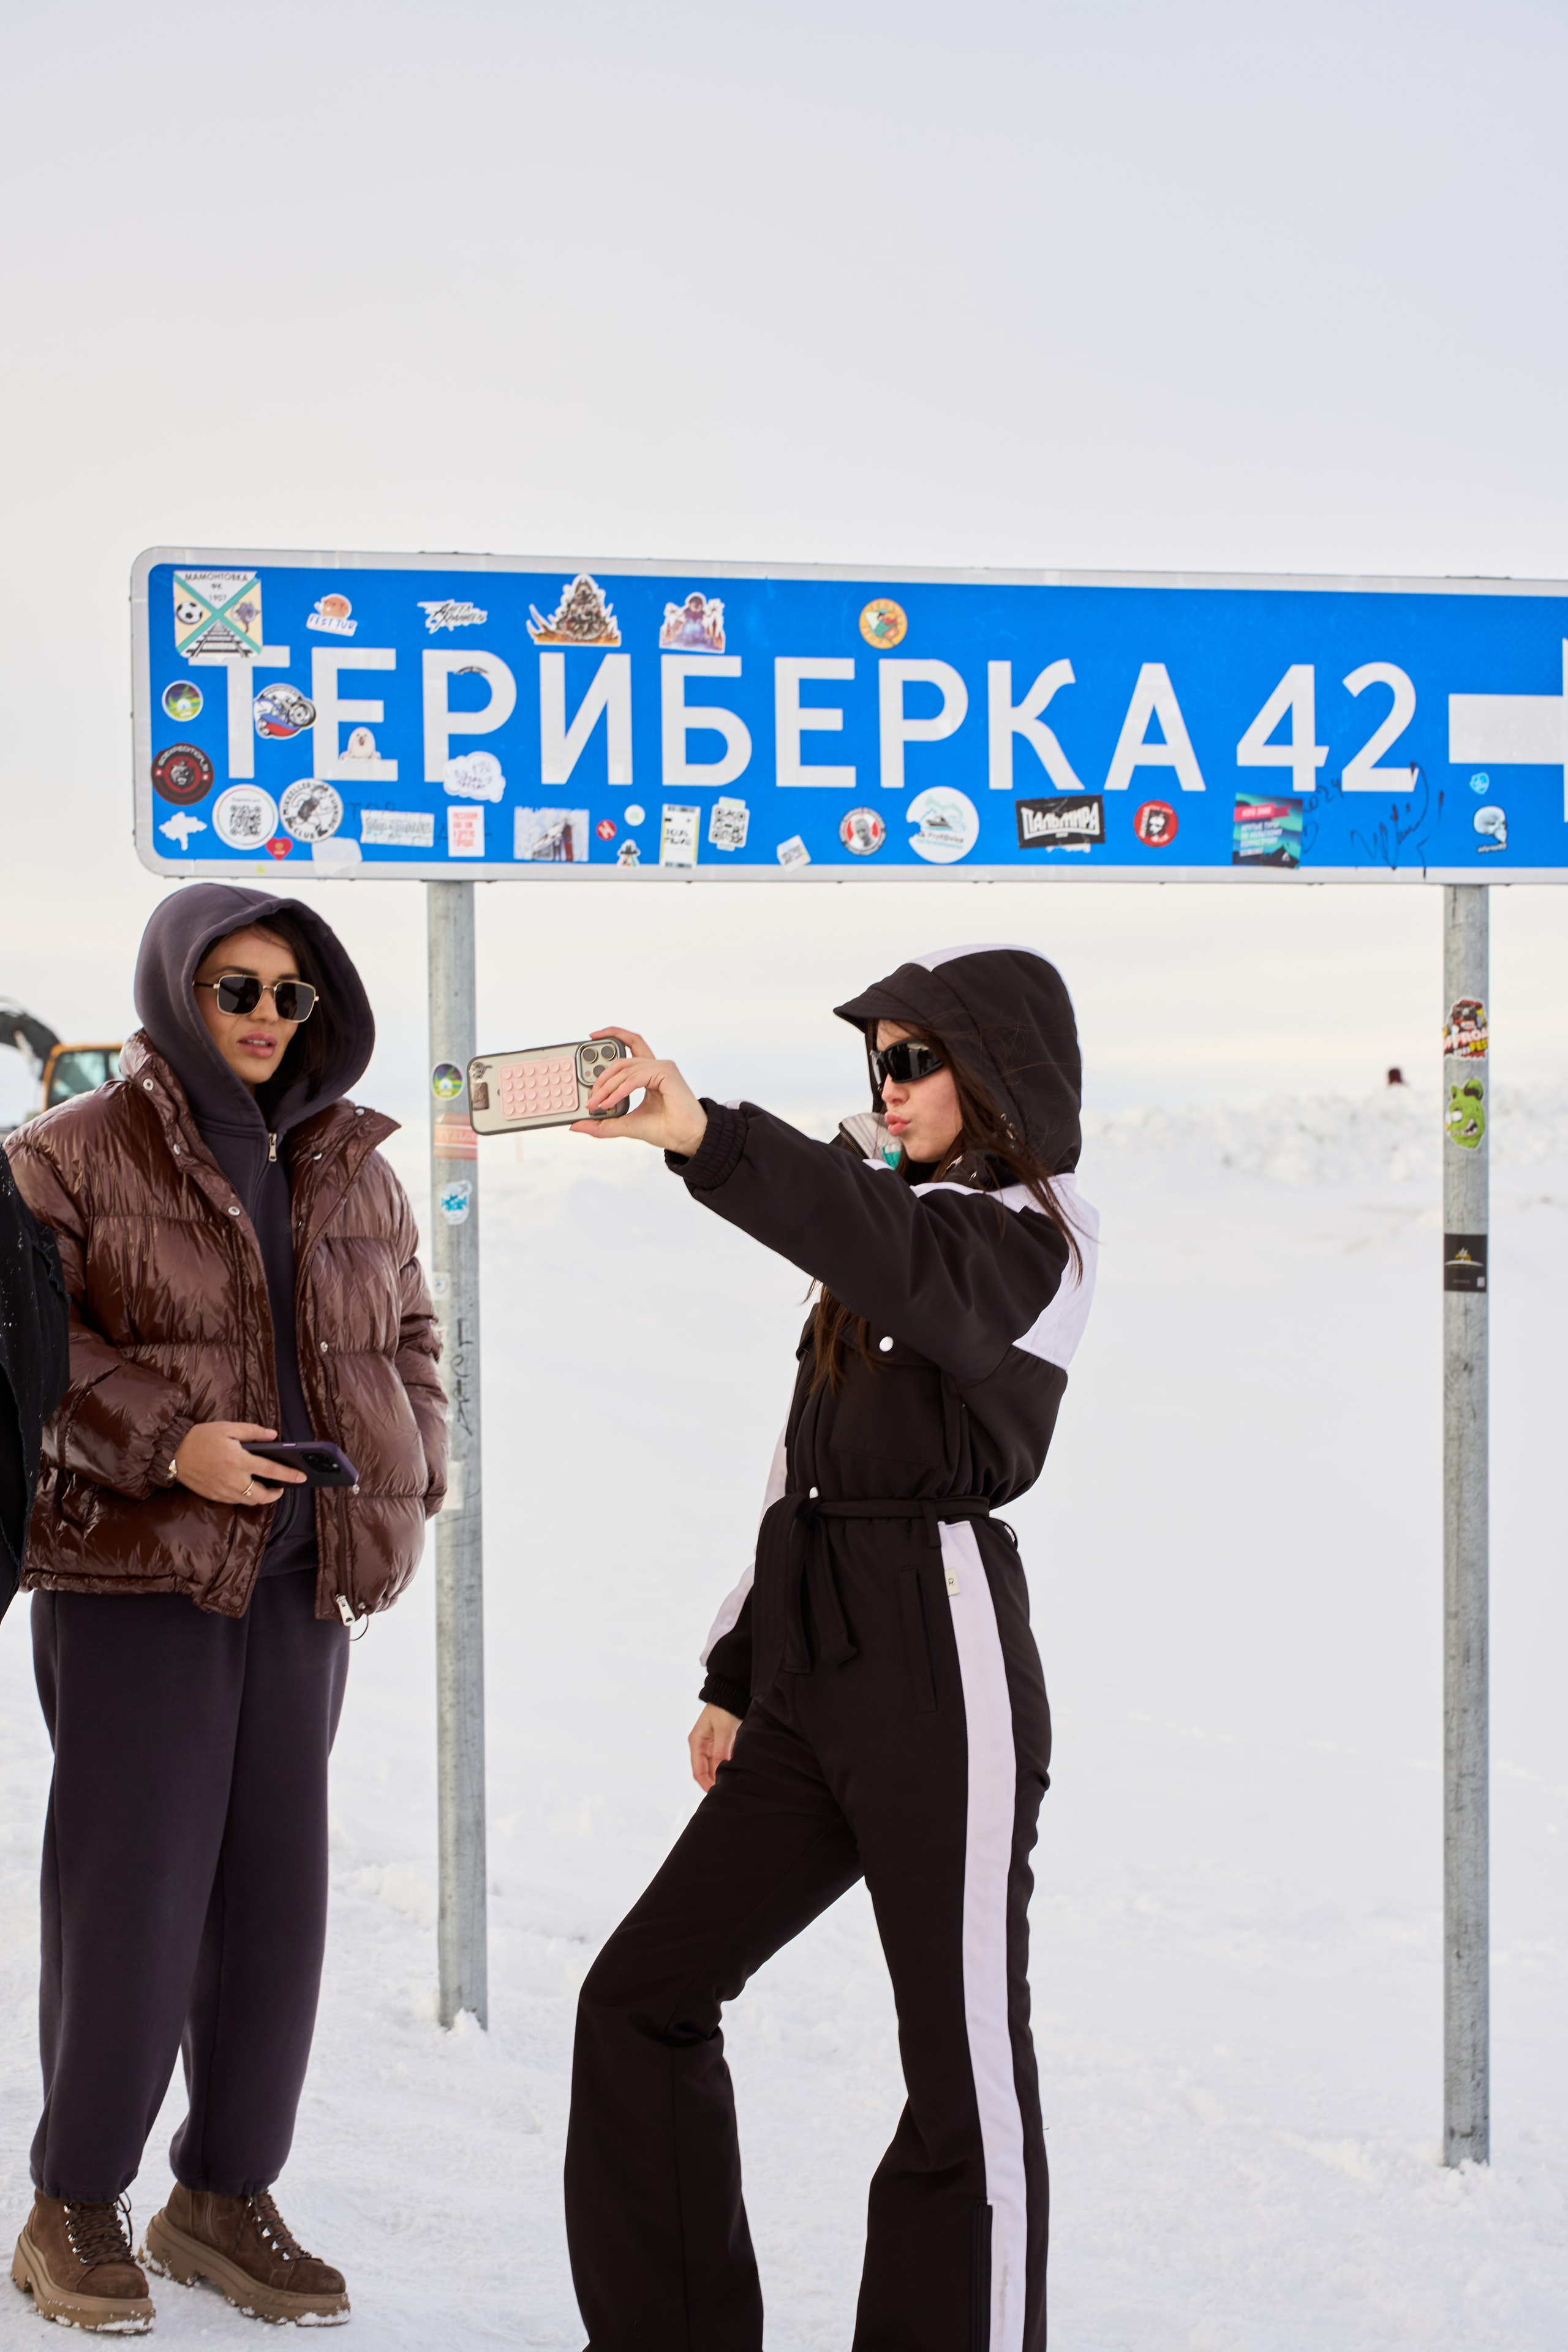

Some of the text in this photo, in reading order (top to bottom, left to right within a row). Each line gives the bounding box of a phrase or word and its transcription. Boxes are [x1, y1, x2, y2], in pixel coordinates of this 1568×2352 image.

[309, 614, 356, 630] FEST TUR
[188, 645, 1420, 792] ТЕРИБЕРКА 42
[293, 827, 315, 840] CLUB
[1020, 802, 1101, 840] ПАЛЬМИРА
